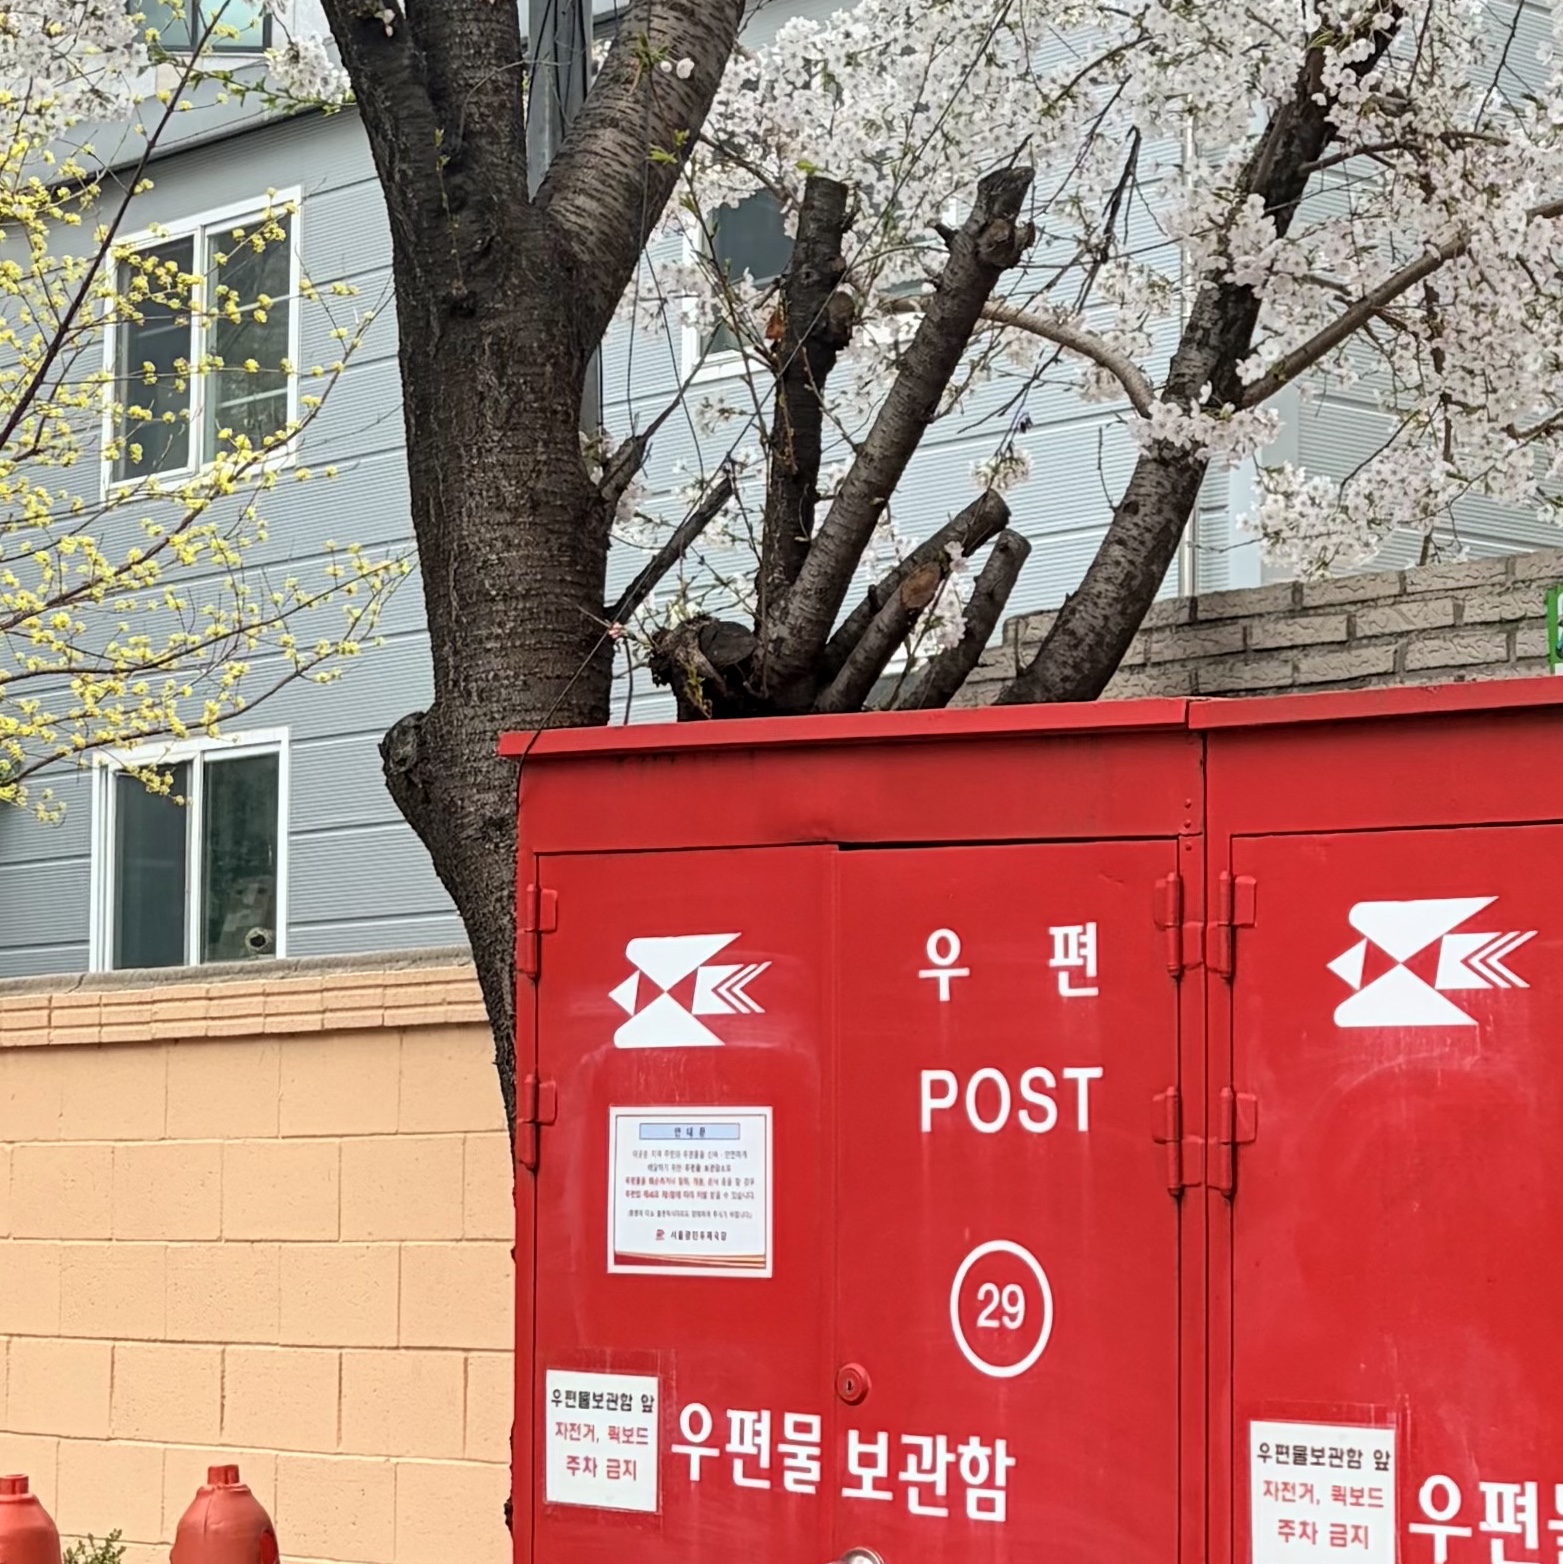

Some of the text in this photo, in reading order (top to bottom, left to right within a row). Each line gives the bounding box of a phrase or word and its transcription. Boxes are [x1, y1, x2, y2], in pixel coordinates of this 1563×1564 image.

[922, 1067, 1103, 1133] POST
[978, 1283, 1025, 1330] 29
[551, 1389, 655, 1413] 우편물보관함 앞
[566, 1455, 637, 1481] 주차 금지
[672, 1403, 1015, 1522] 우편물 보관함
[1257, 1442, 1391, 1472] 우편물보관함 앞
[1331, 1485, 1384, 1508] 퀵보드
[1278, 1519, 1369, 1550] 주차 금지
